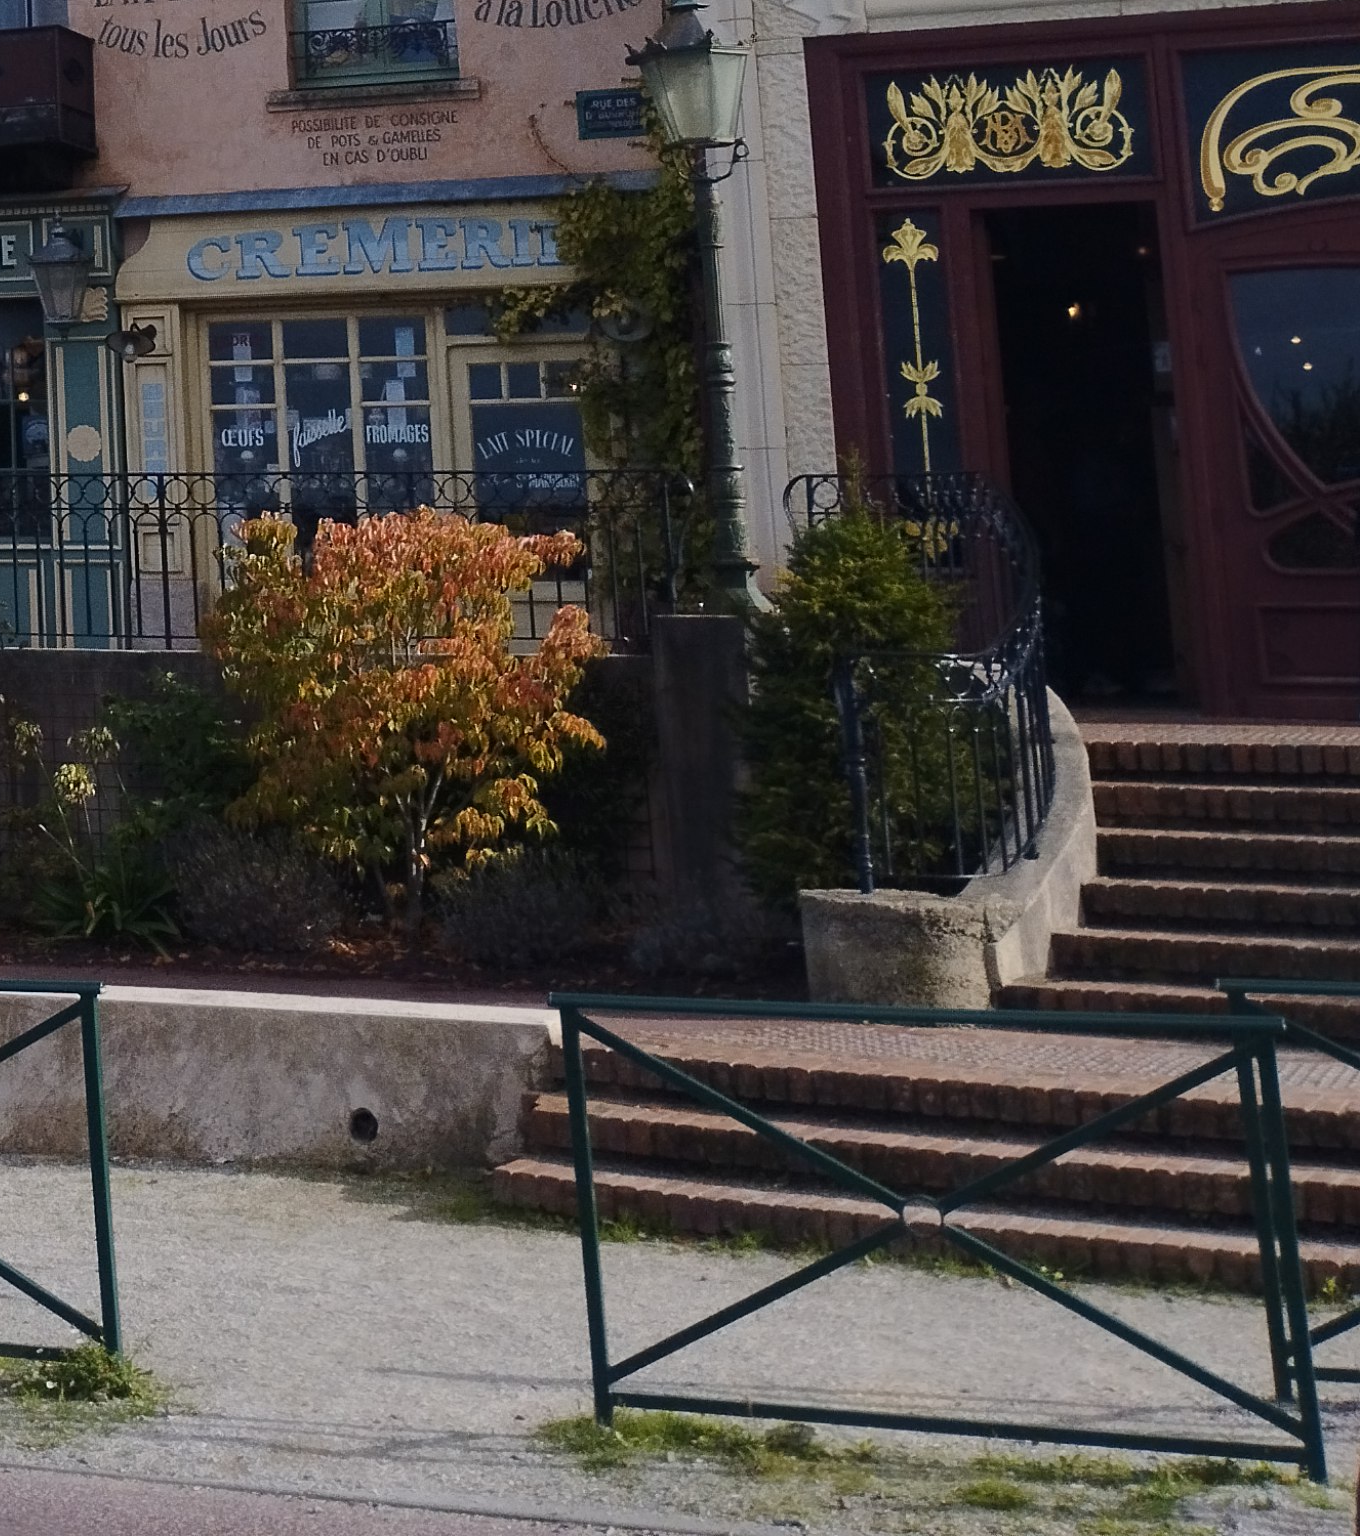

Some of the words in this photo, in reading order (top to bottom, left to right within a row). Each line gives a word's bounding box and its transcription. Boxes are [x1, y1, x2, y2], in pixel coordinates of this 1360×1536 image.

[97, 16, 148, 56] tous
[152, 18, 189, 58] les
[197, 9, 267, 56] Jours
[292, 116, 357, 133] POSSIBILITE
[365, 115, 381, 128] DE
[390, 110, 458, 127] CONSIGNE
[308, 136, 321, 149] DE
[331, 134, 361, 148] POTS
[368, 135, 378, 146] &
[383, 129, 441, 145] GAMELLES
[323, 152, 339, 166] EN
[345, 150, 369, 164] CAS
[377, 147, 428, 163] D'OUBLI
[221, 428, 264, 447] ŒUFS
[292, 408, 350, 468] faisselle
[366, 423, 430, 444] FROMAGES
[477, 431, 509, 459] LAIT
[515, 429, 574, 457] SPECIAL
